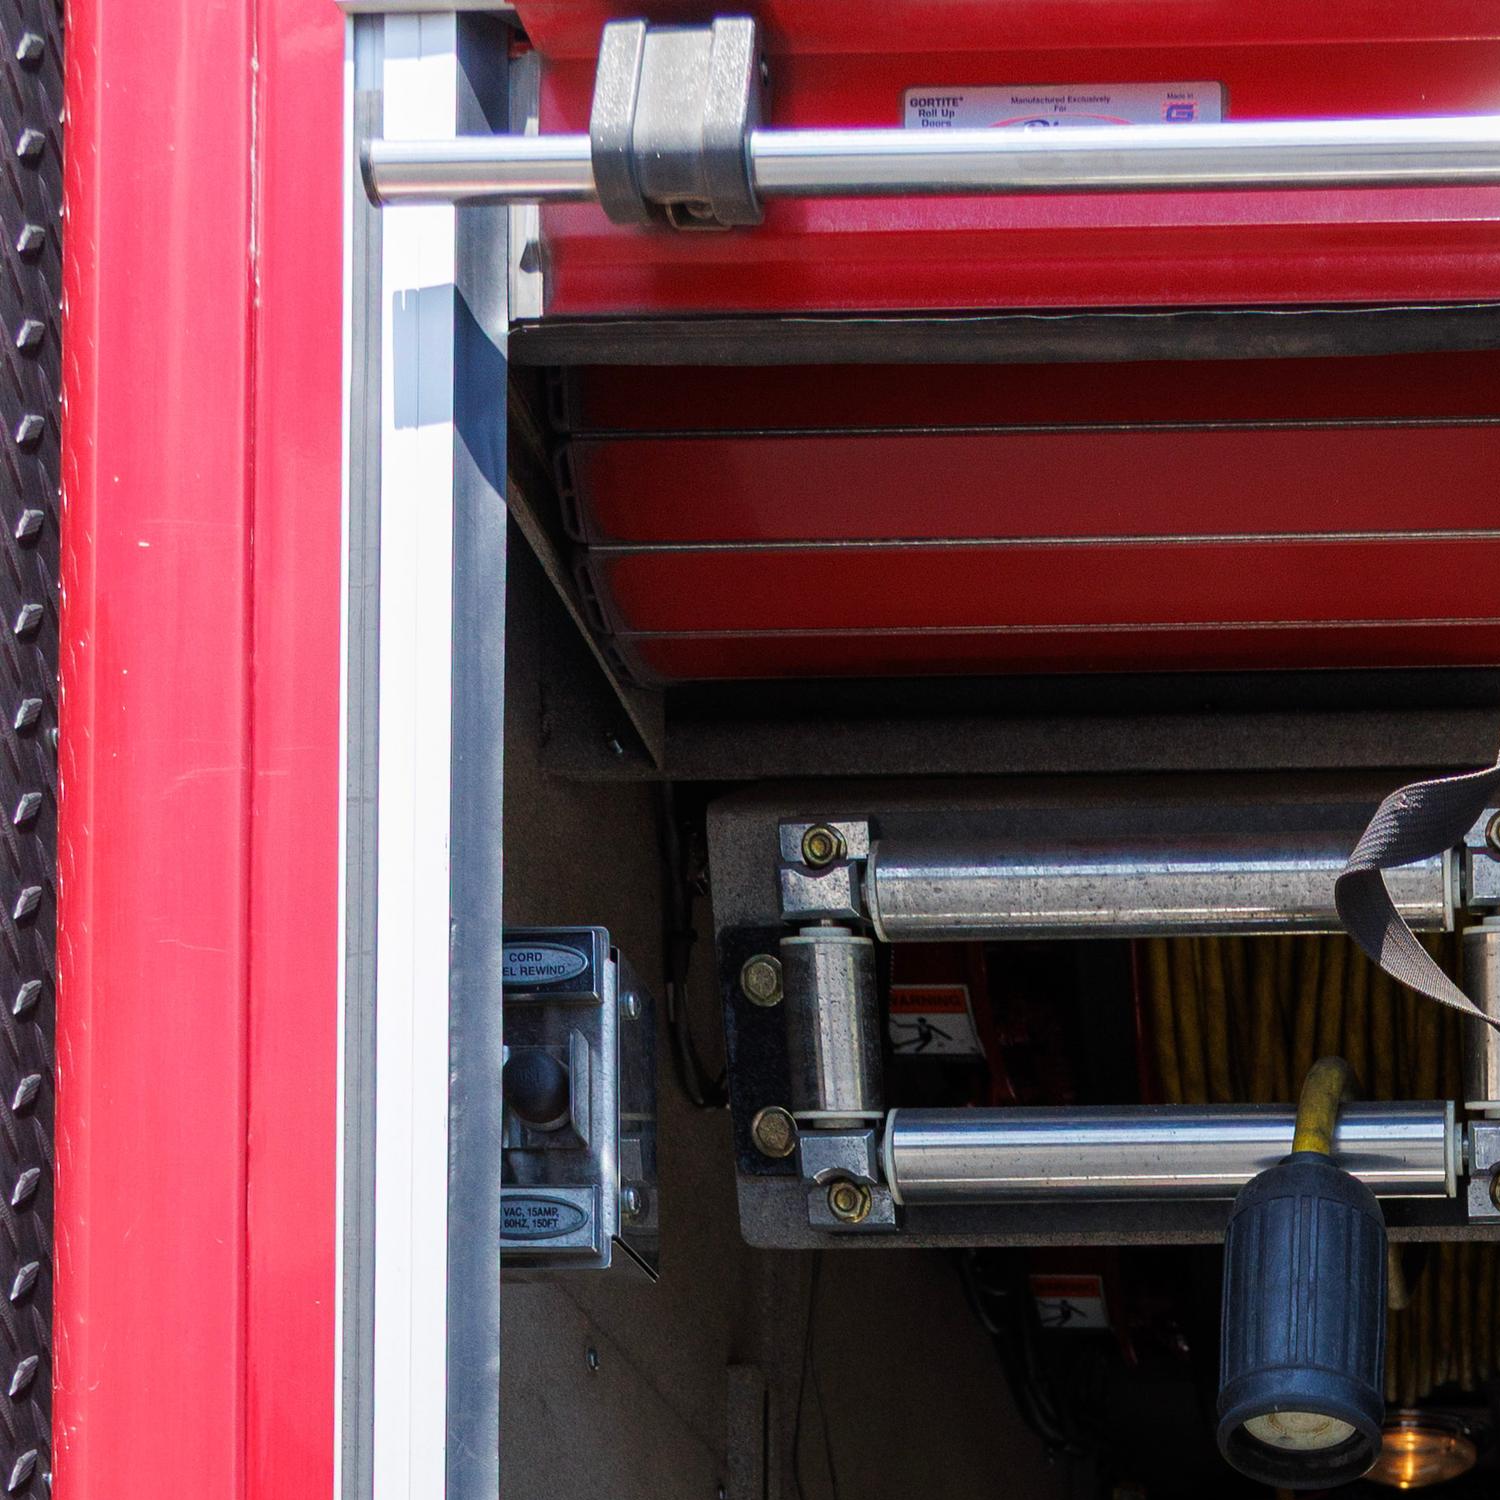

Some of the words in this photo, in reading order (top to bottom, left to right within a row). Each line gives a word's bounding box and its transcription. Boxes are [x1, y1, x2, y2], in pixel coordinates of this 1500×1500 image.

[1010, 96, 1065, 105] Manufactured
[1067, 95, 1111, 104] Exclusively
[918, 109, 938, 118] Roll
[941, 109, 955, 118] Up
[921, 119, 952, 127] Doors
[509, 952, 543, 963] CORD
[502, 966, 517, 977] EL
[520, 965, 566, 976] REWIND
[504, 1207, 525, 1217] VAC,
[527, 1207, 560, 1217] 15AMP,
[504, 1219, 530, 1229] 60HZ,
[532, 1219, 559, 1228] 150FT
